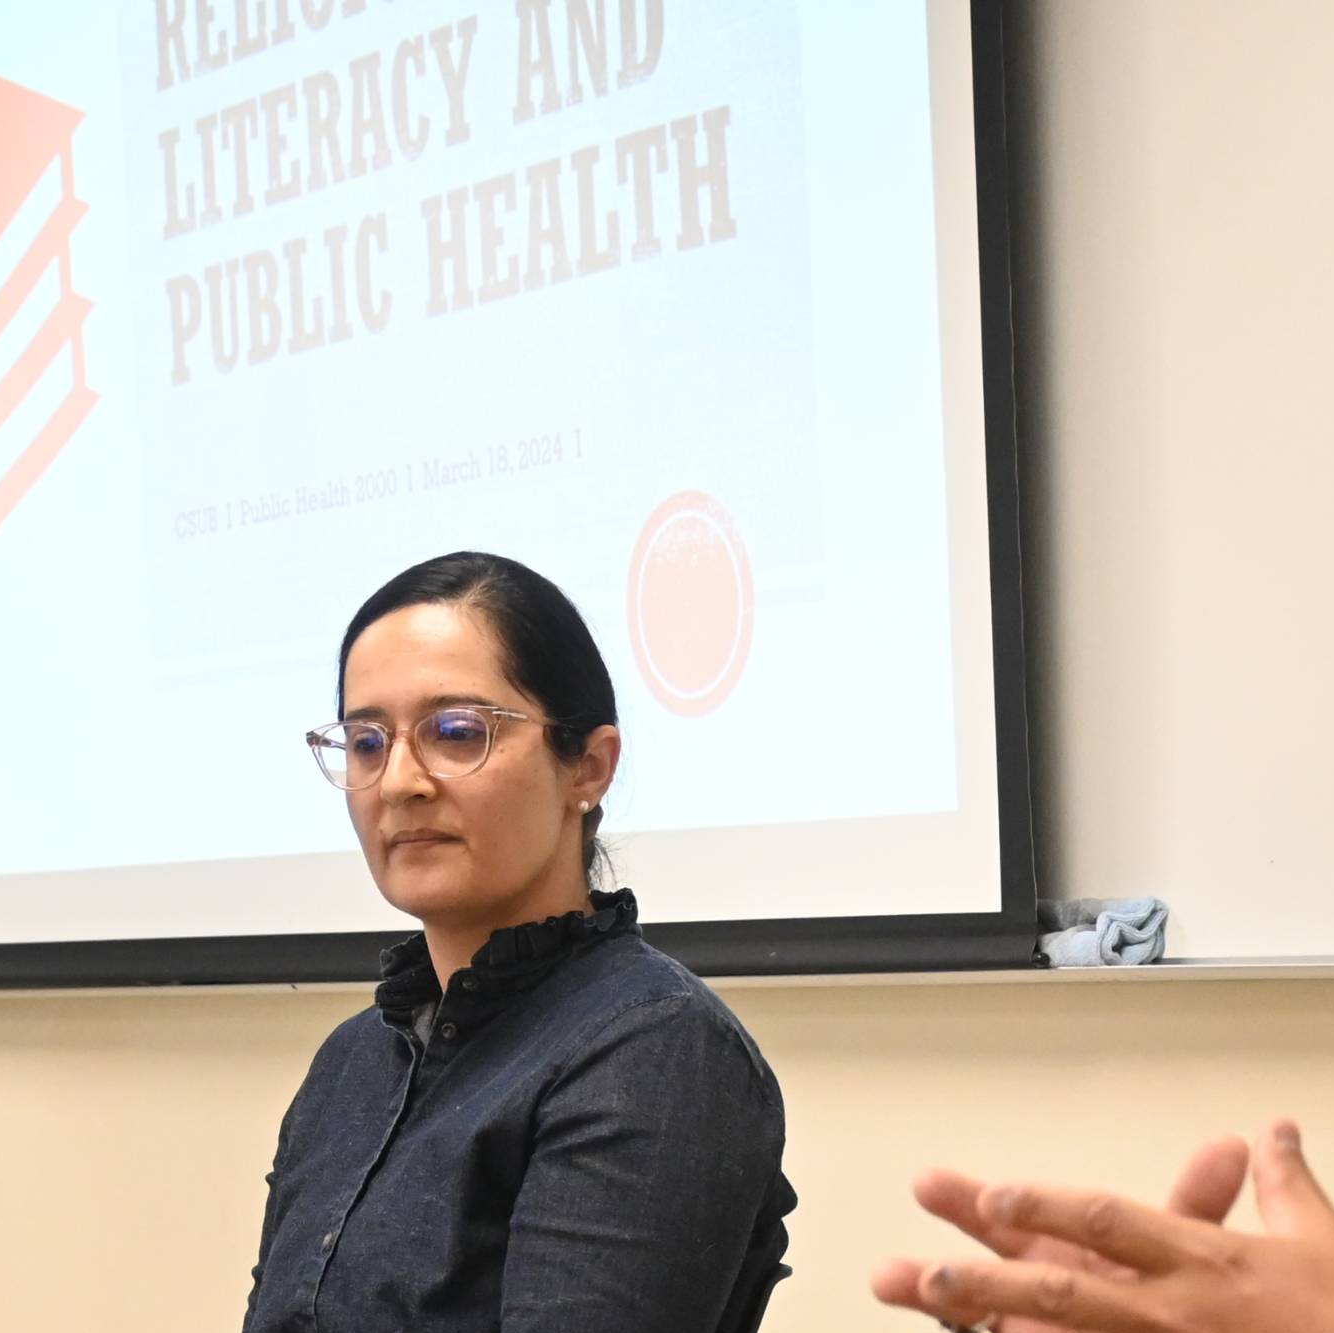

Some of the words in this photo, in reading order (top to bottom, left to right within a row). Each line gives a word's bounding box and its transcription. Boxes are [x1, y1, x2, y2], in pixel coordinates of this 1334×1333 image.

[158, 15, 478, 241] LITERACY
[512, 0, 665, 125] AND
[165, 211, 394, 387] PUBLIC
[420, 104, 738, 318] HEALTH
[174, 506, 218, 540] CSUB
[239, 488, 291, 528] Public
[294, 477, 352, 516] Health
[355, 467, 397, 504] 2000
[422, 448, 483, 491] March
[487, 442, 515, 478] 18,
[517, 431, 564, 471] 2024
